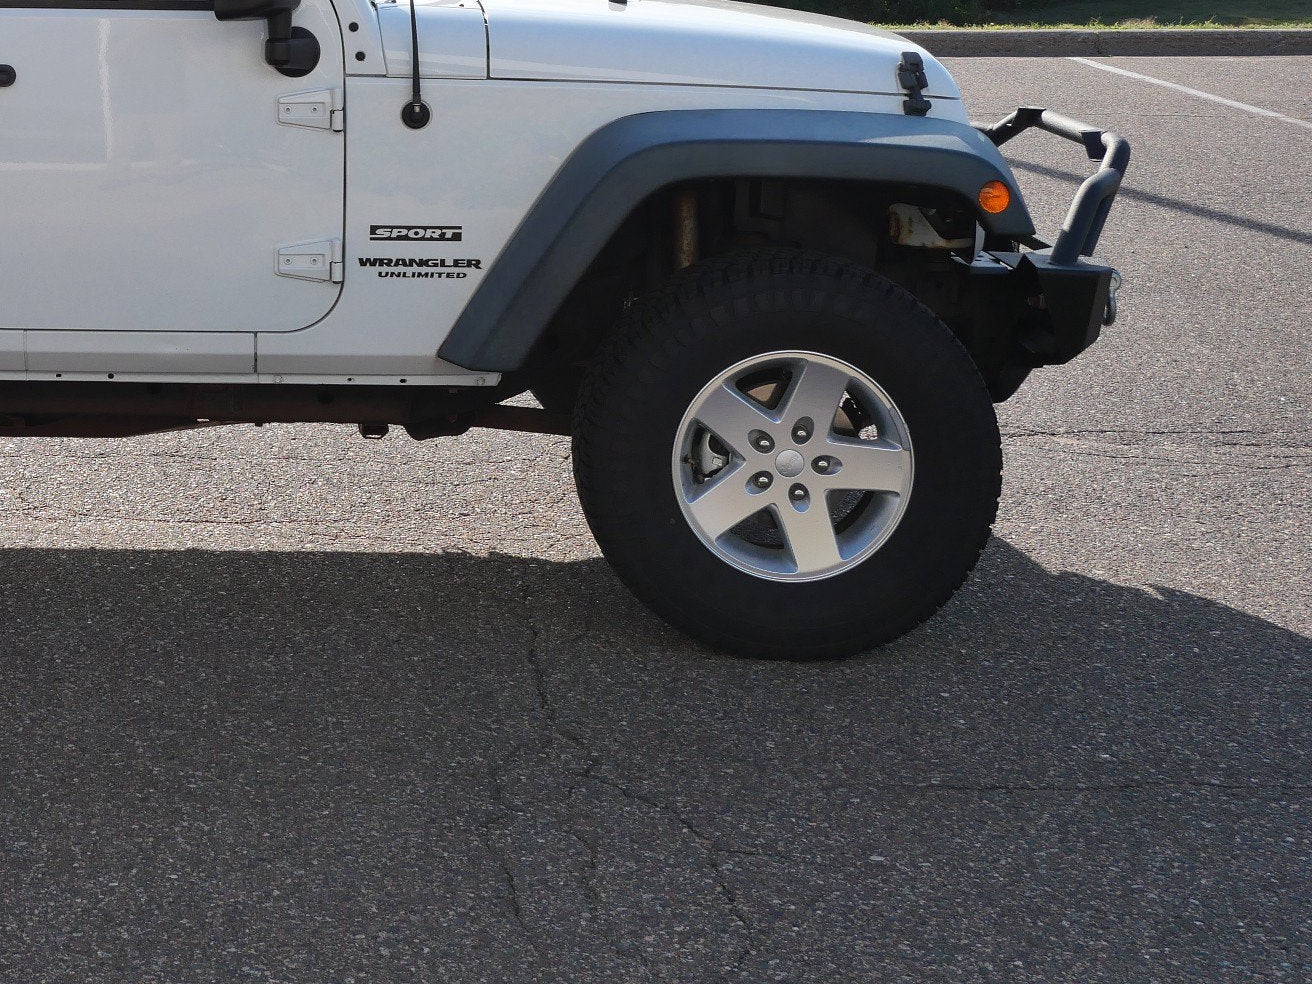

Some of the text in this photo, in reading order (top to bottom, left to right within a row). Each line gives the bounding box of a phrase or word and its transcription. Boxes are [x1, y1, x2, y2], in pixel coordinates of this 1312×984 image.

[371, 227, 461, 240] SPORT
[358, 257, 482, 269] WRANGLER
[377, 271, 467, 279] UNLIMITED
